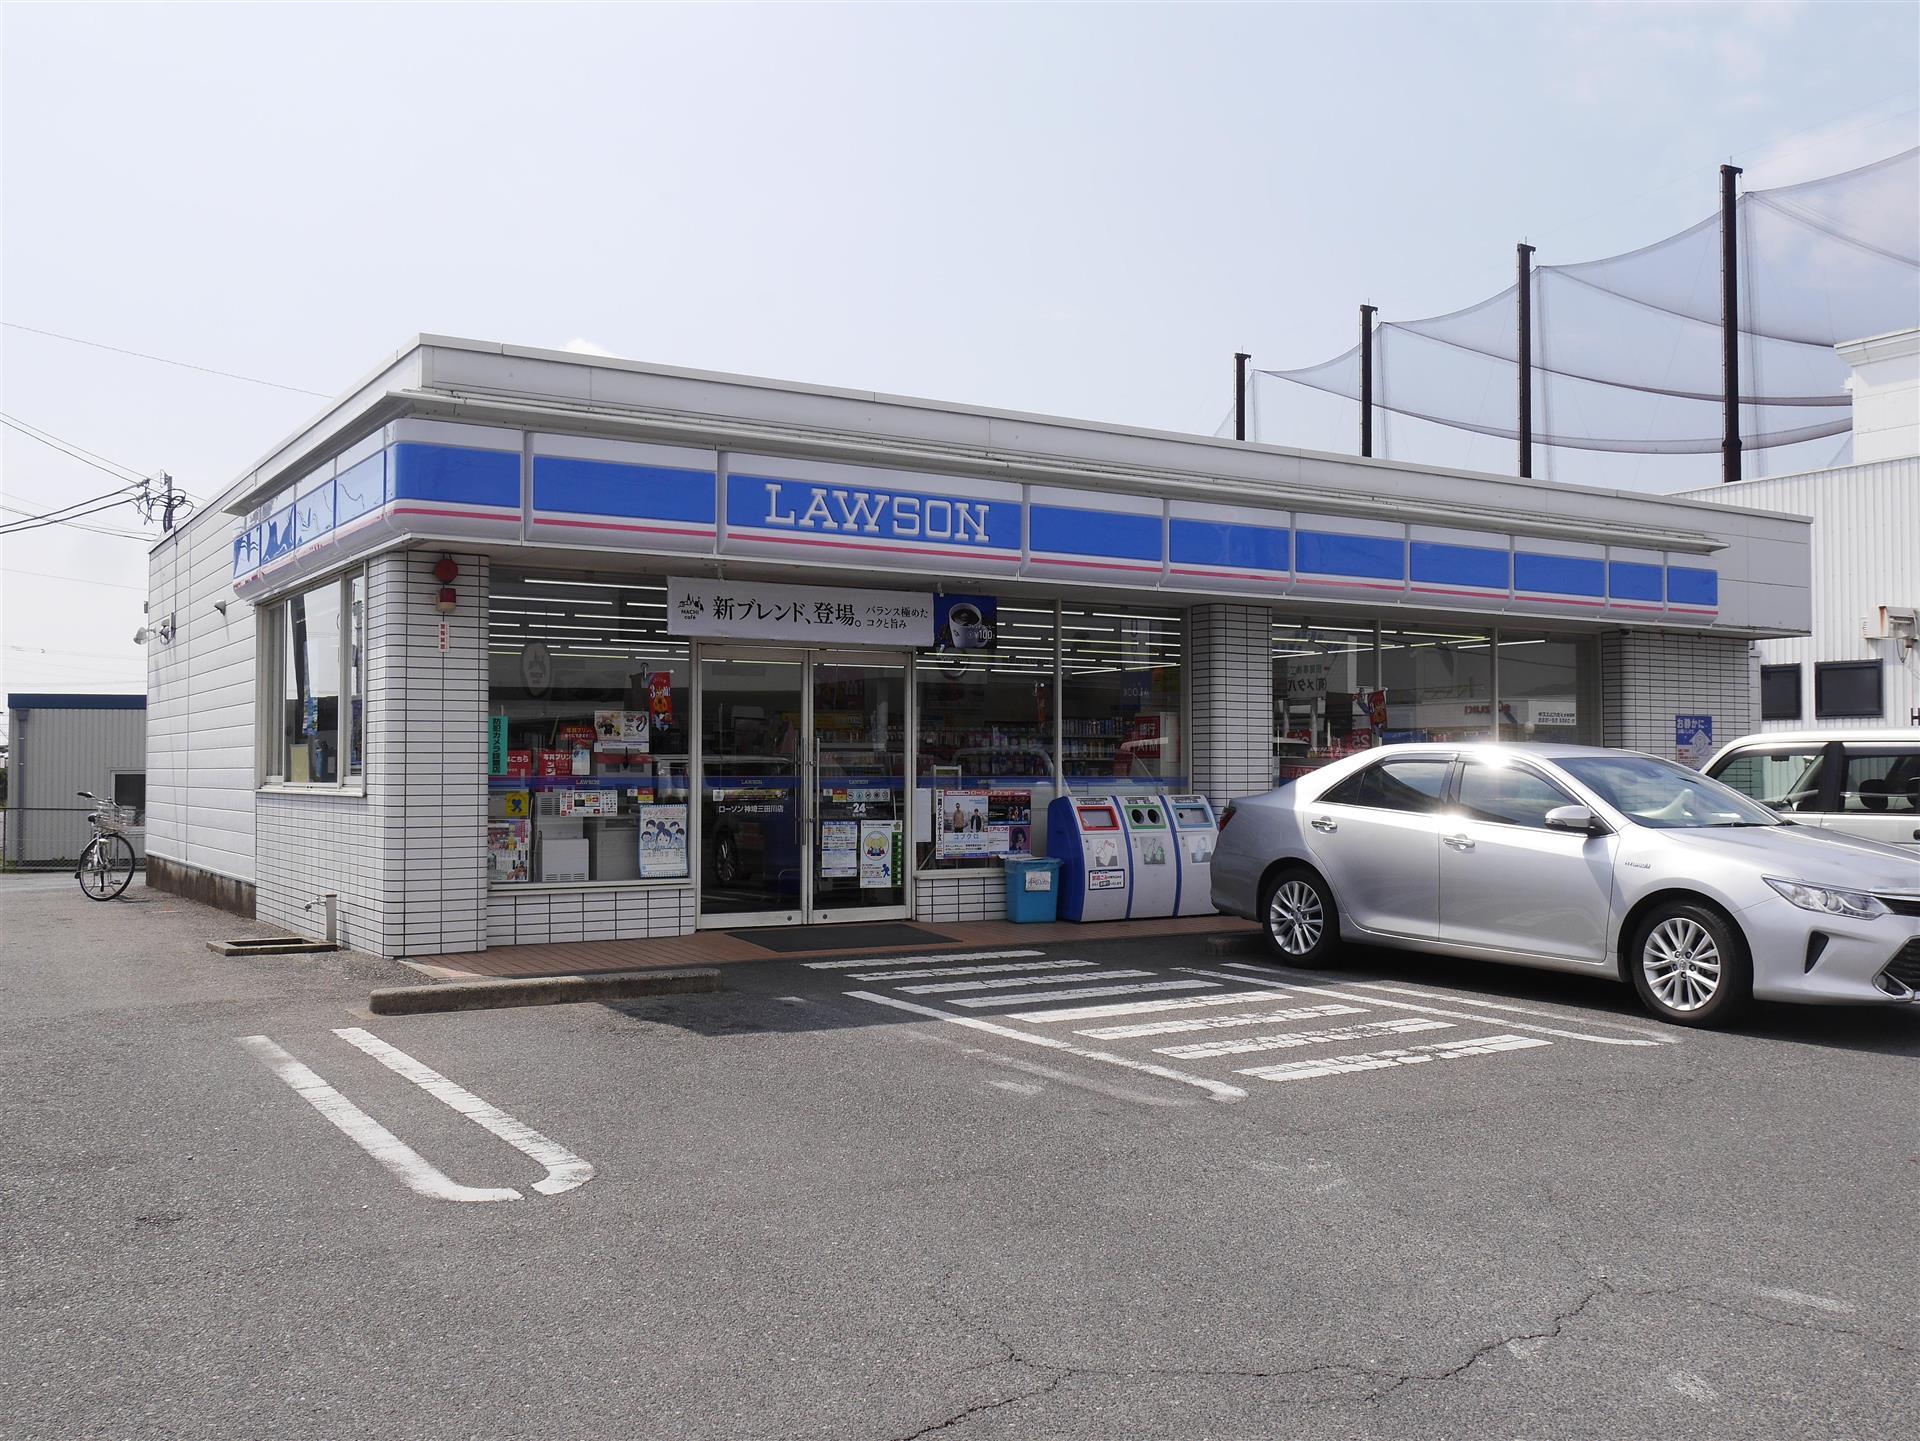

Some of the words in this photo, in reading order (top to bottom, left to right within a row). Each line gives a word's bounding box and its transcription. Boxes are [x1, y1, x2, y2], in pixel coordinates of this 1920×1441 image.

[765, 482, 990, 543] LAWSON
[713, 595, 862, 628] 新ブレンド、登場。
[866, 605, 928, 619] バランス極めた
[867, 617, 907, 629] コクと旨み
[852, 803, 866, 813] 24
